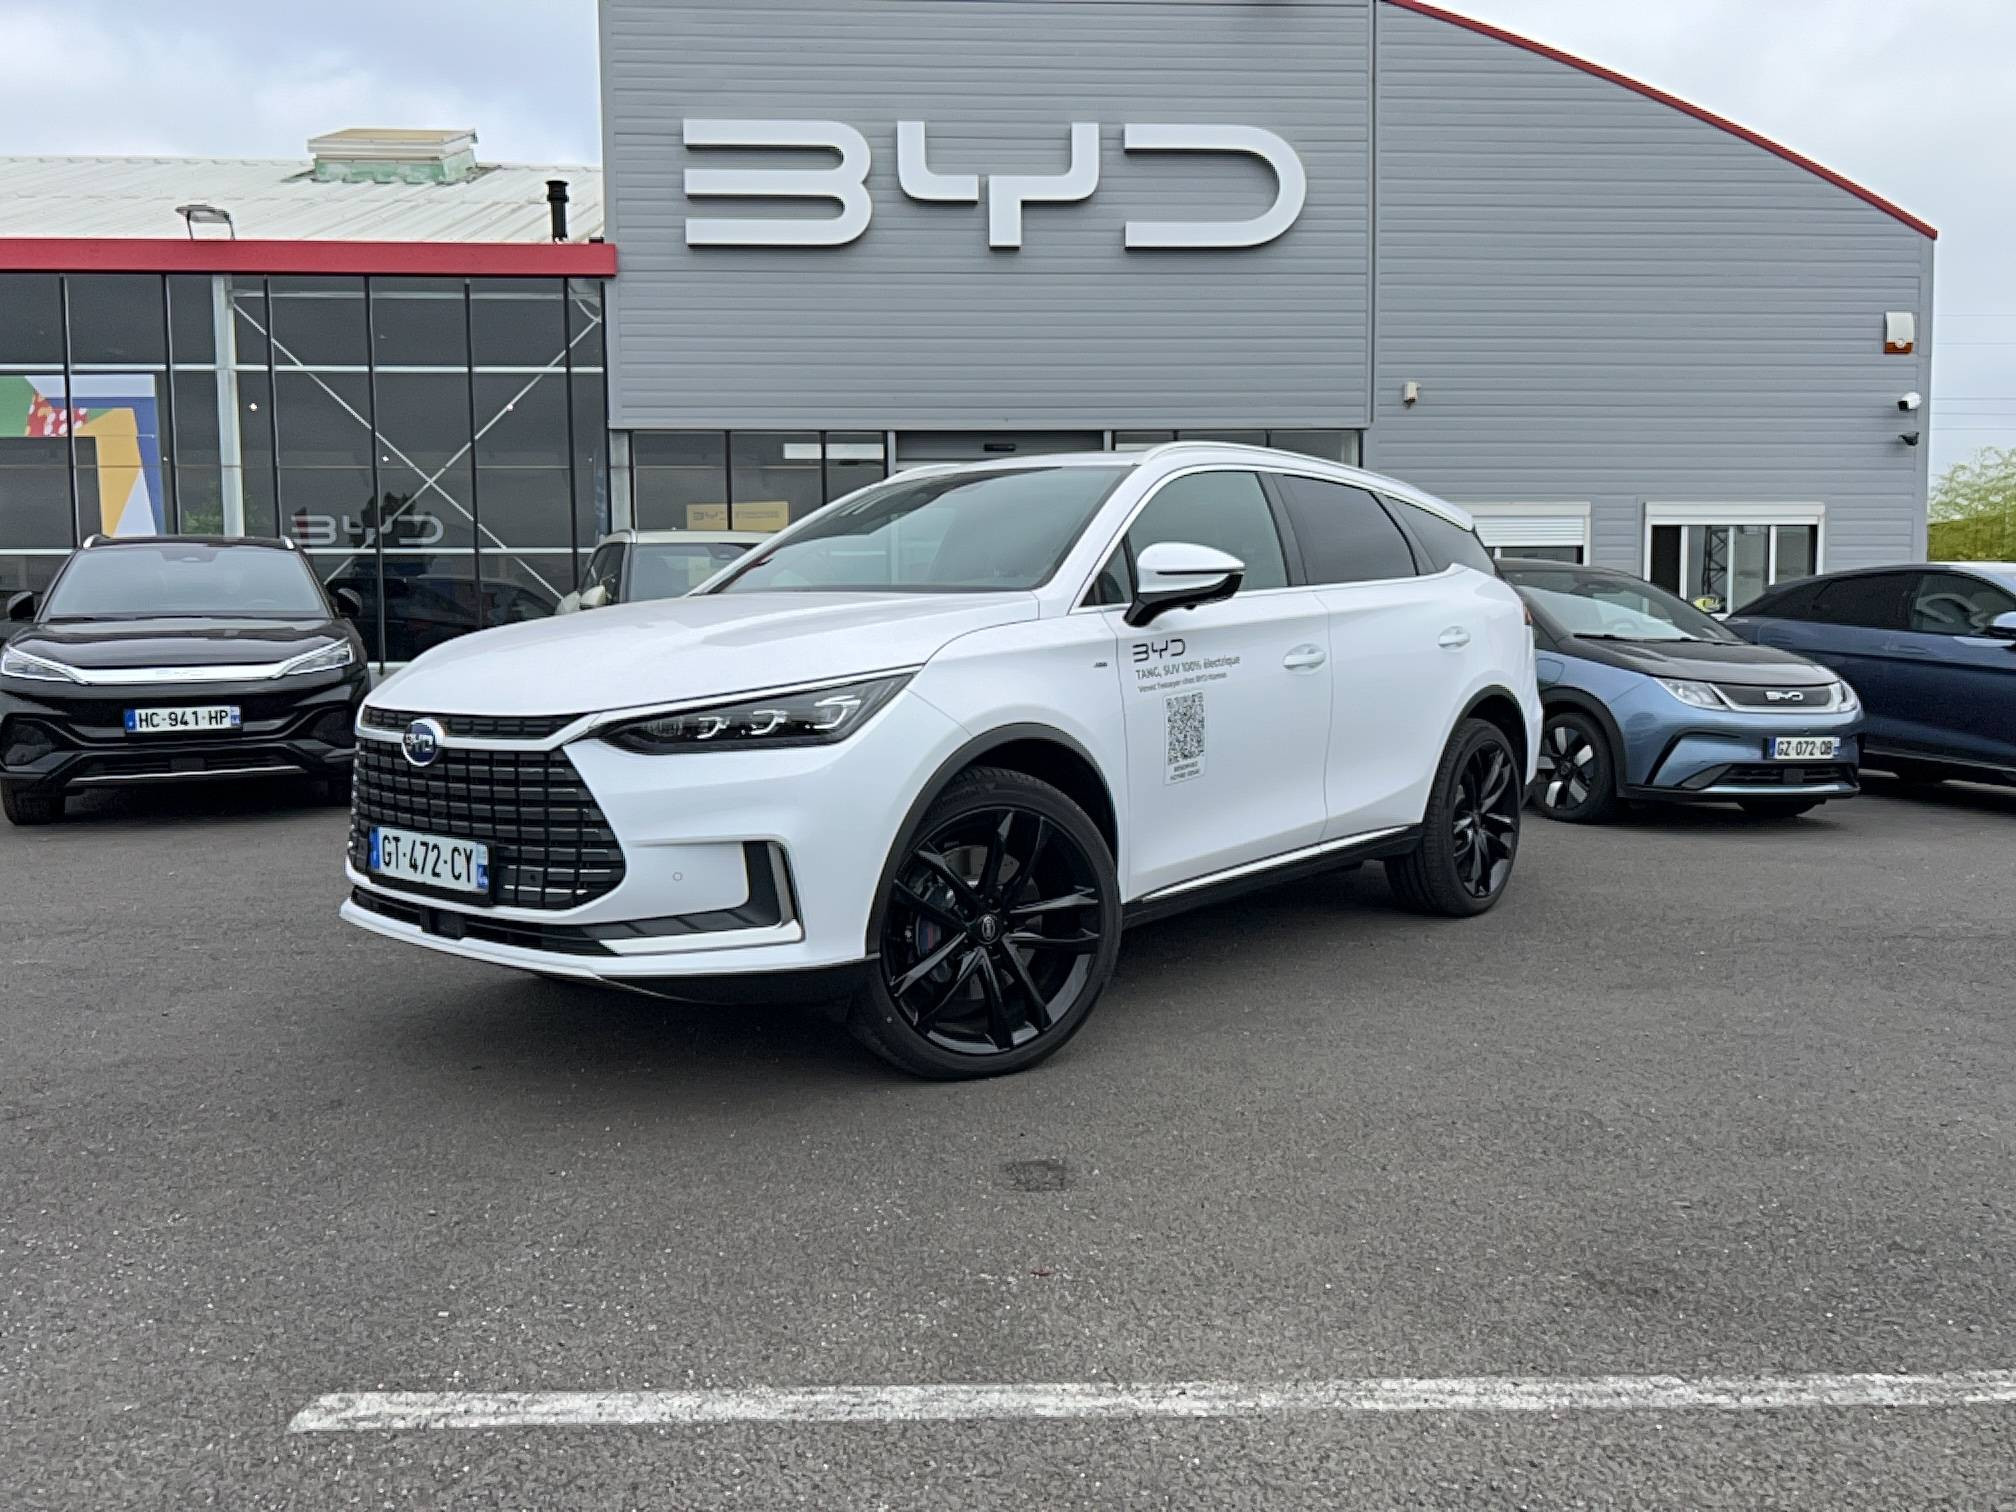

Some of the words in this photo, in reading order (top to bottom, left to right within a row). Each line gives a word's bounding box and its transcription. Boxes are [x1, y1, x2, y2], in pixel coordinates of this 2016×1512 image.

[683, 119, 1308, 250] BYD
[291, 514, 444, 545] BYD
[1132, 638, 1186, 663] BYD
[138, 709, 229, 729] HC-941-HP
[381, 834, 474, 884] GT-472-CY
